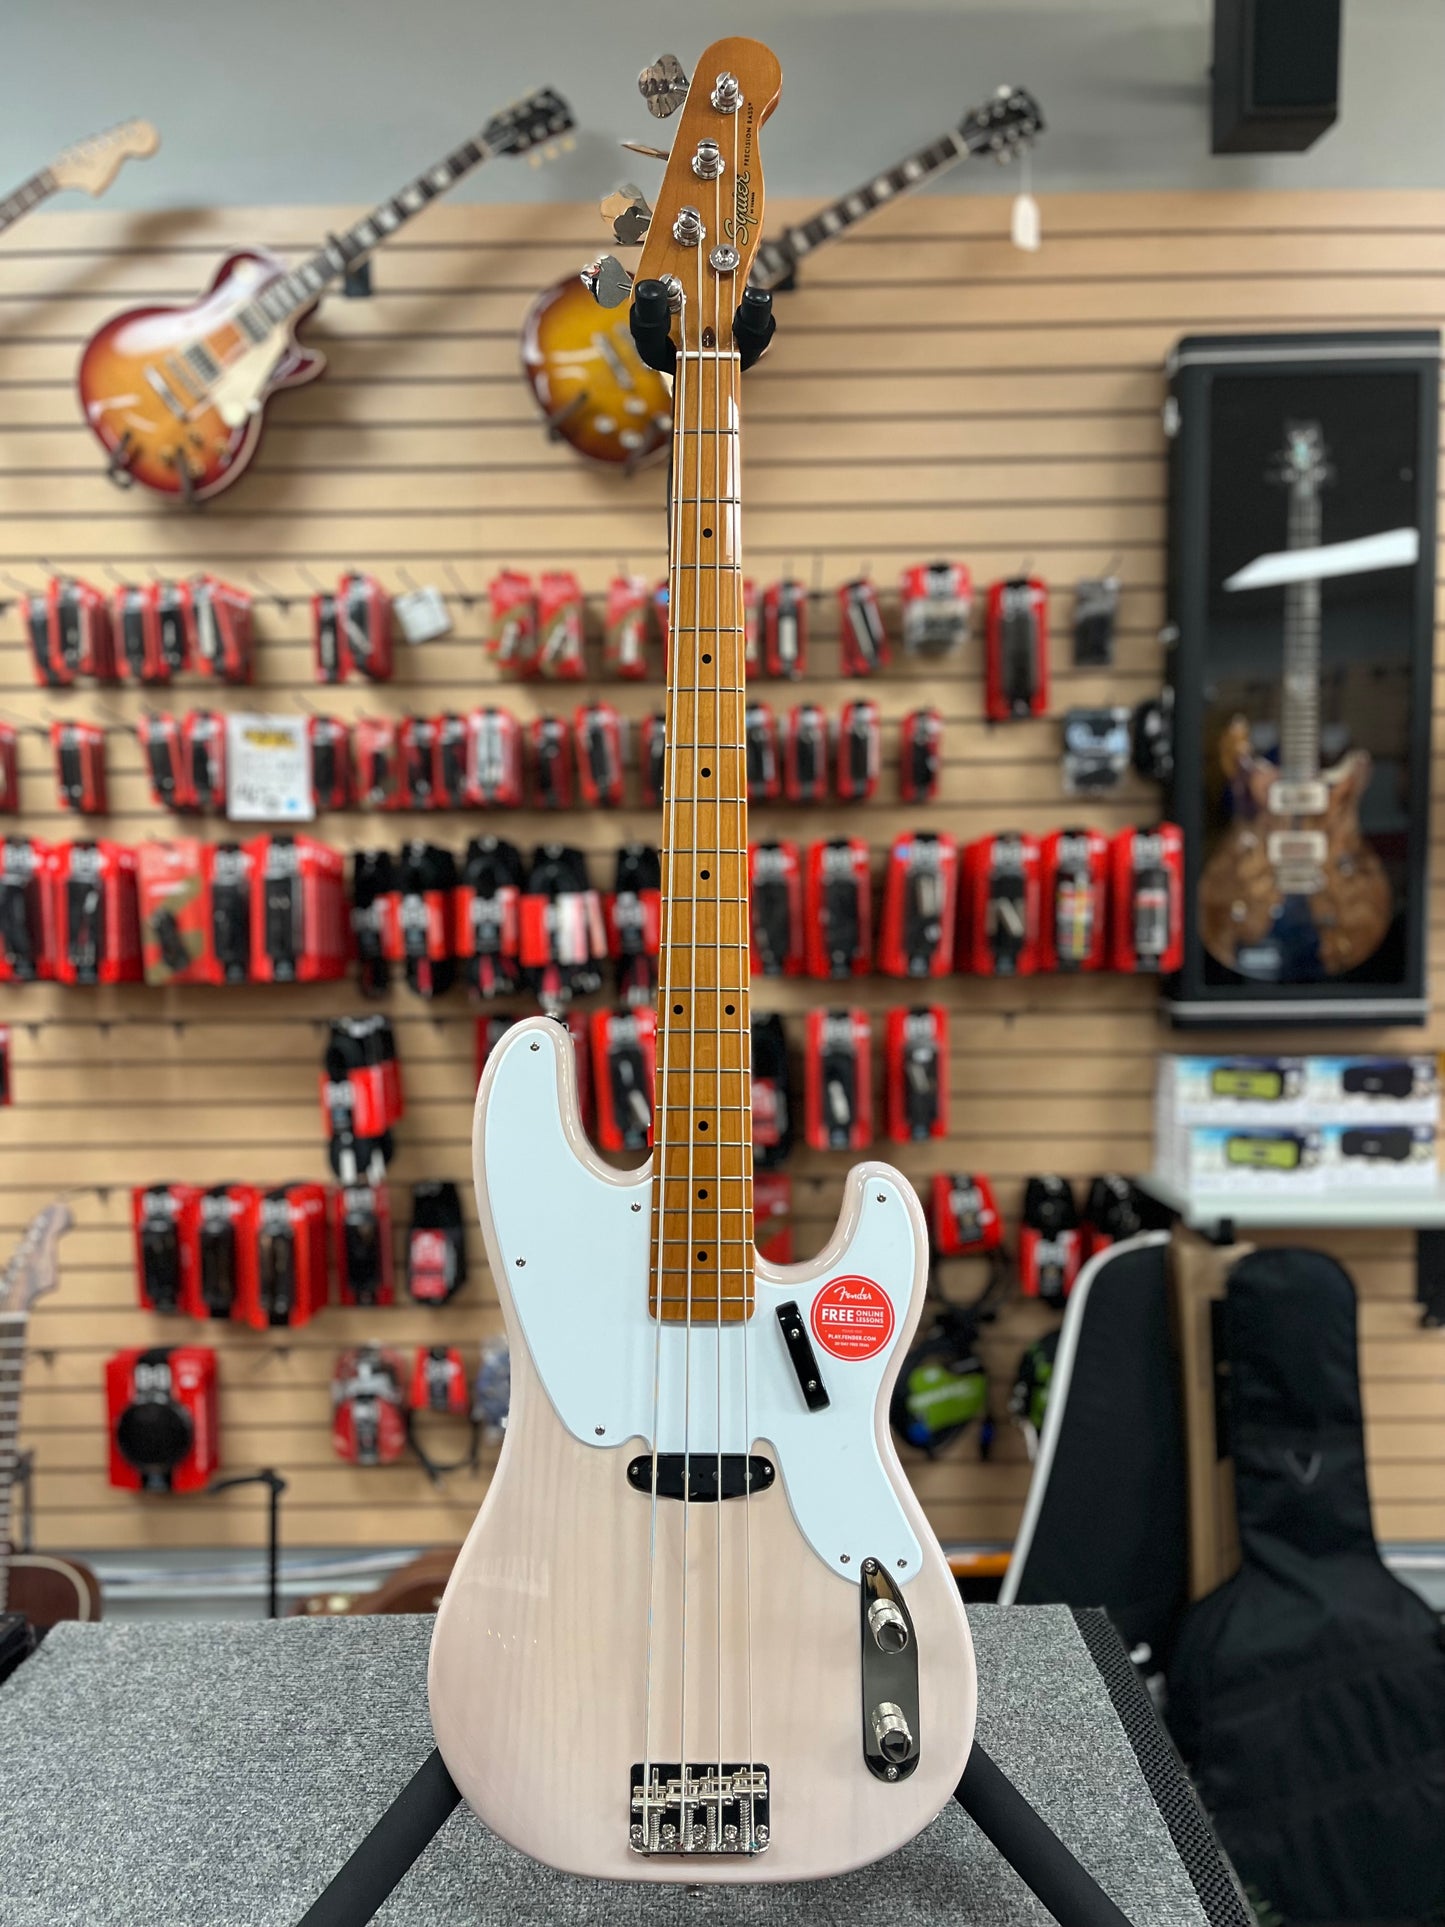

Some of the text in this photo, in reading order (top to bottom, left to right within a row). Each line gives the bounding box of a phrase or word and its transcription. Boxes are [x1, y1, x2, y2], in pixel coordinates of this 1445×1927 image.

[723, 171, 758, 246] Squier
[834, 1286, 872, 1302] Fender
[822, 1308, 854, 1322] FREE
